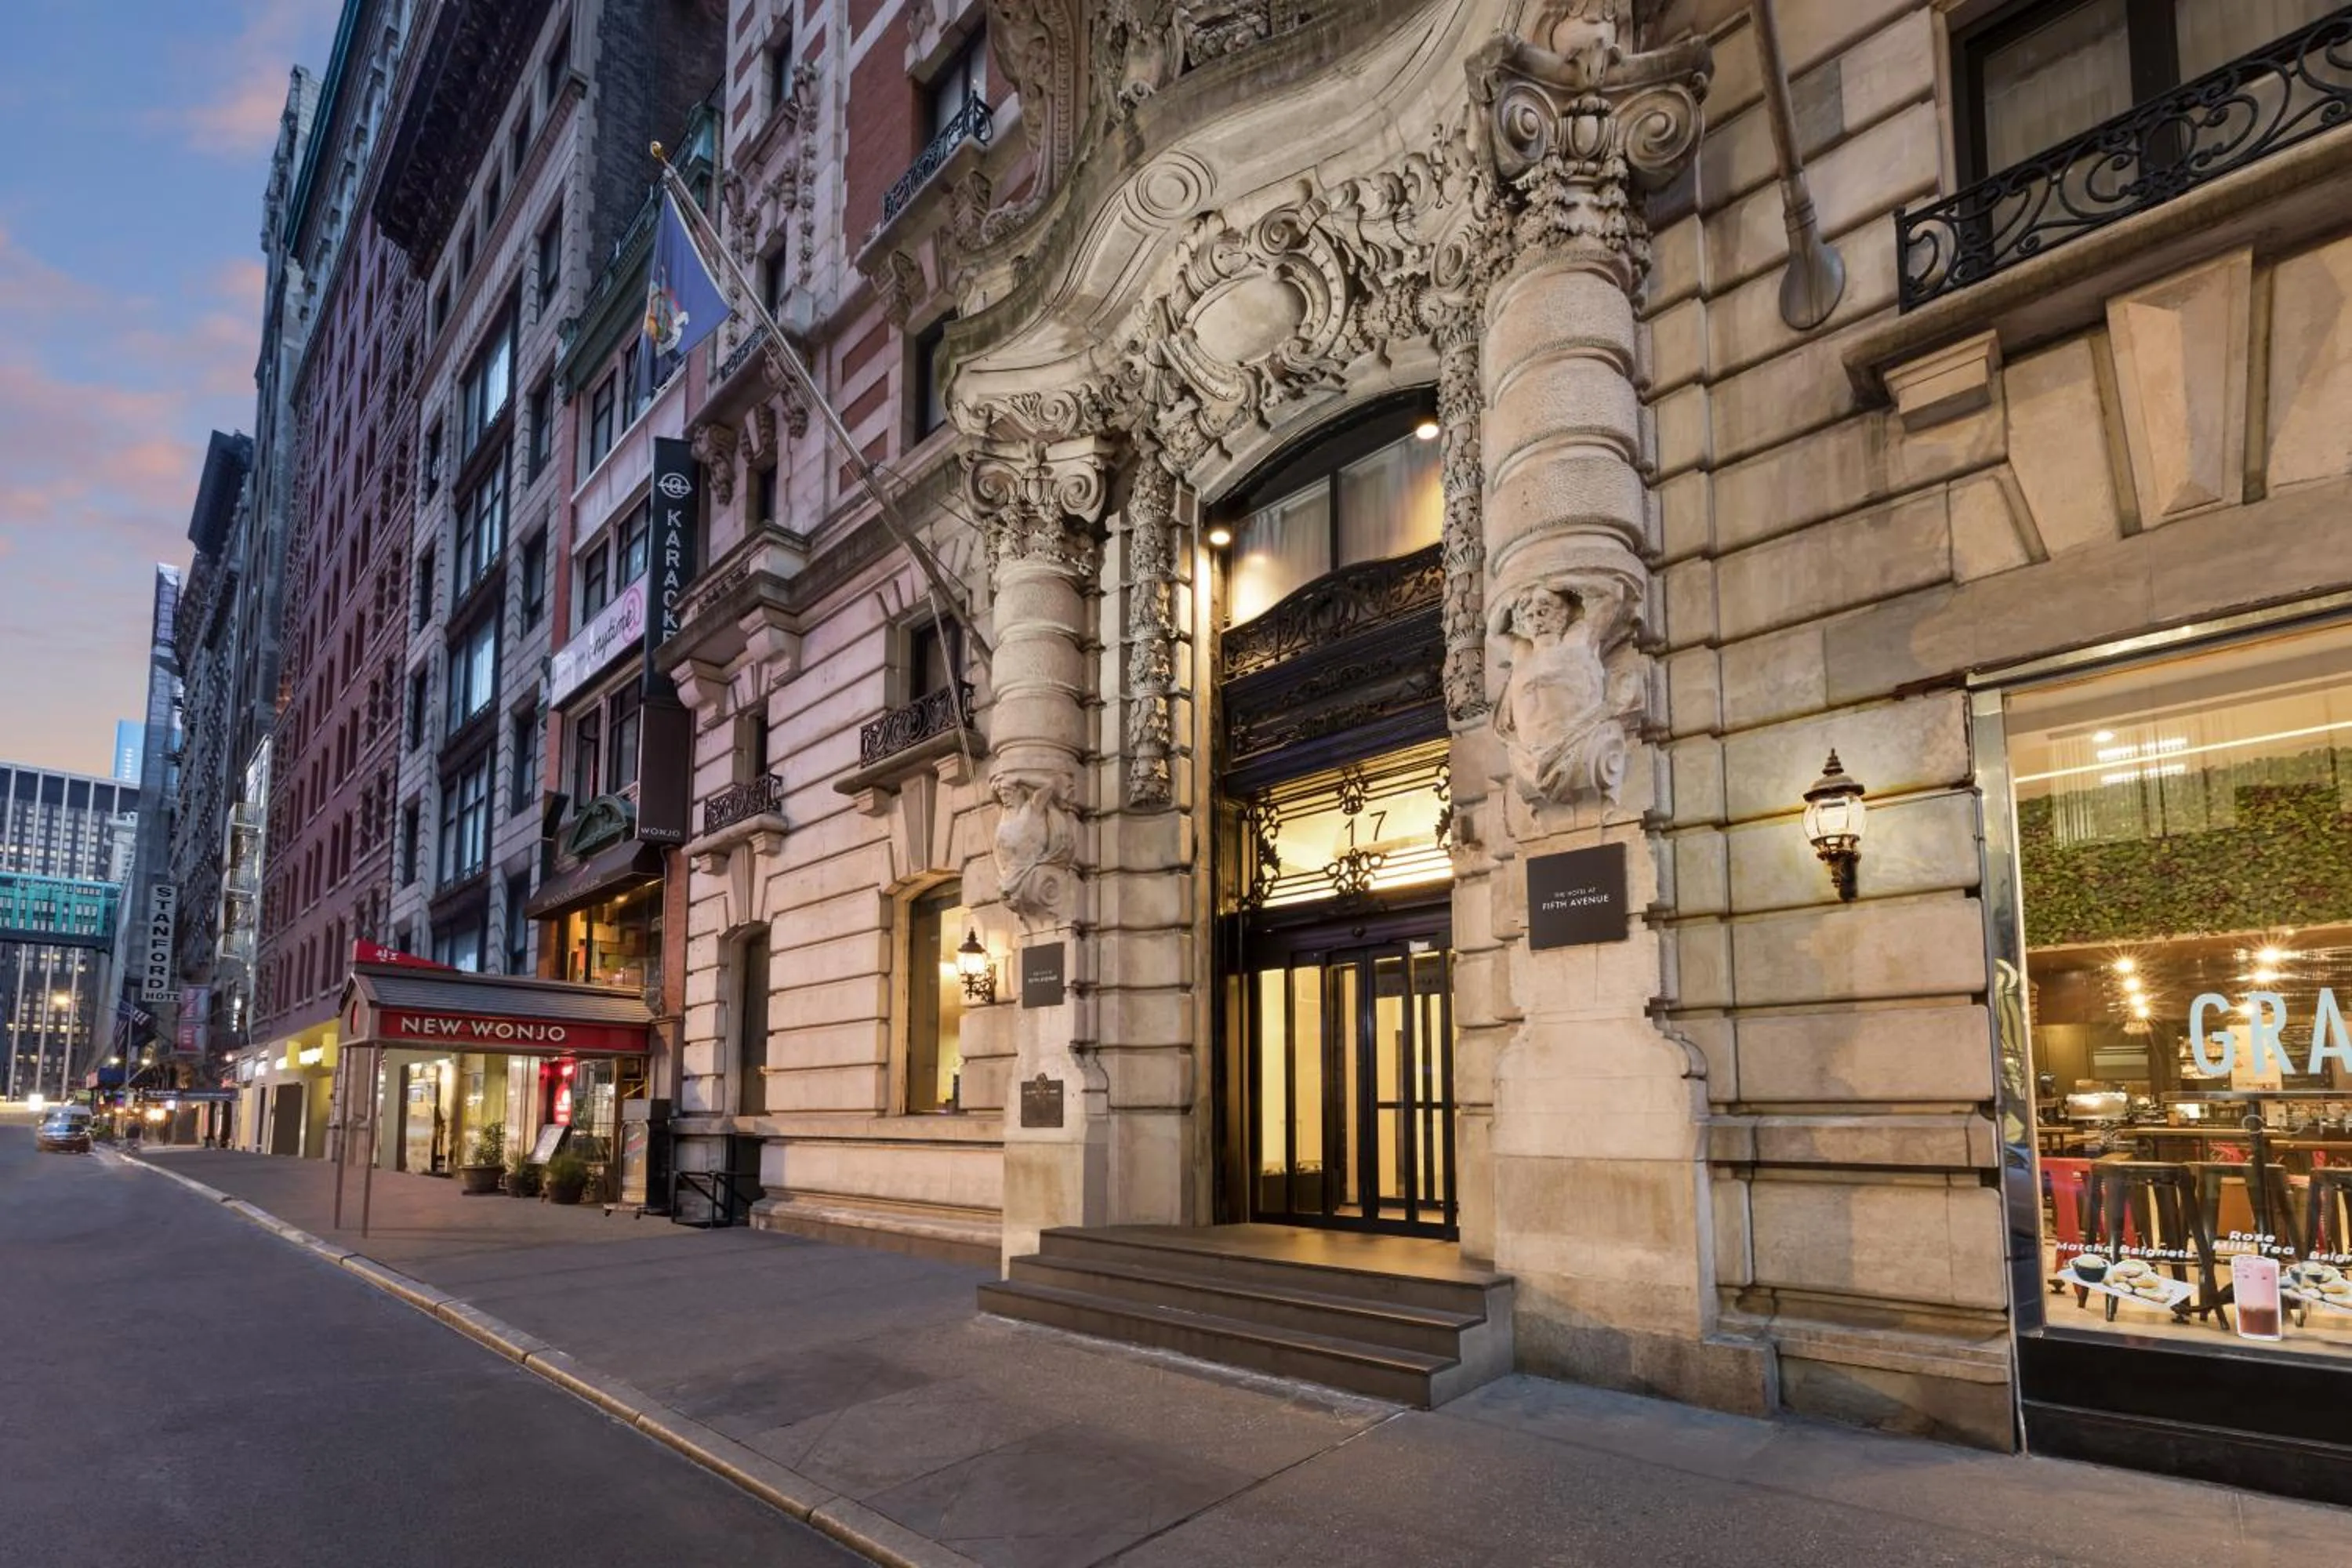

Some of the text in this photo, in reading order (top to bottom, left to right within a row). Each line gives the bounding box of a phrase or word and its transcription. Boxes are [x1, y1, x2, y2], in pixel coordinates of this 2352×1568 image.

[641, 827, 681, 837] WONJO
[1345, 810, 1387, 848] 17
[1542, 894, 1609, 910] FIFTH AVENUE
[147, 887, 172, 989] STANFORD
[401, 1017, 565, 1042] NEW WONJO
[2190, 987, 2352, 1076] GRA
[2229, 1230, 2276, 1243] Rose
[2056, 1241, 2194, 1258] Matcha Beignets
[2212, 1240, 2296, 1255] Milk Tea
